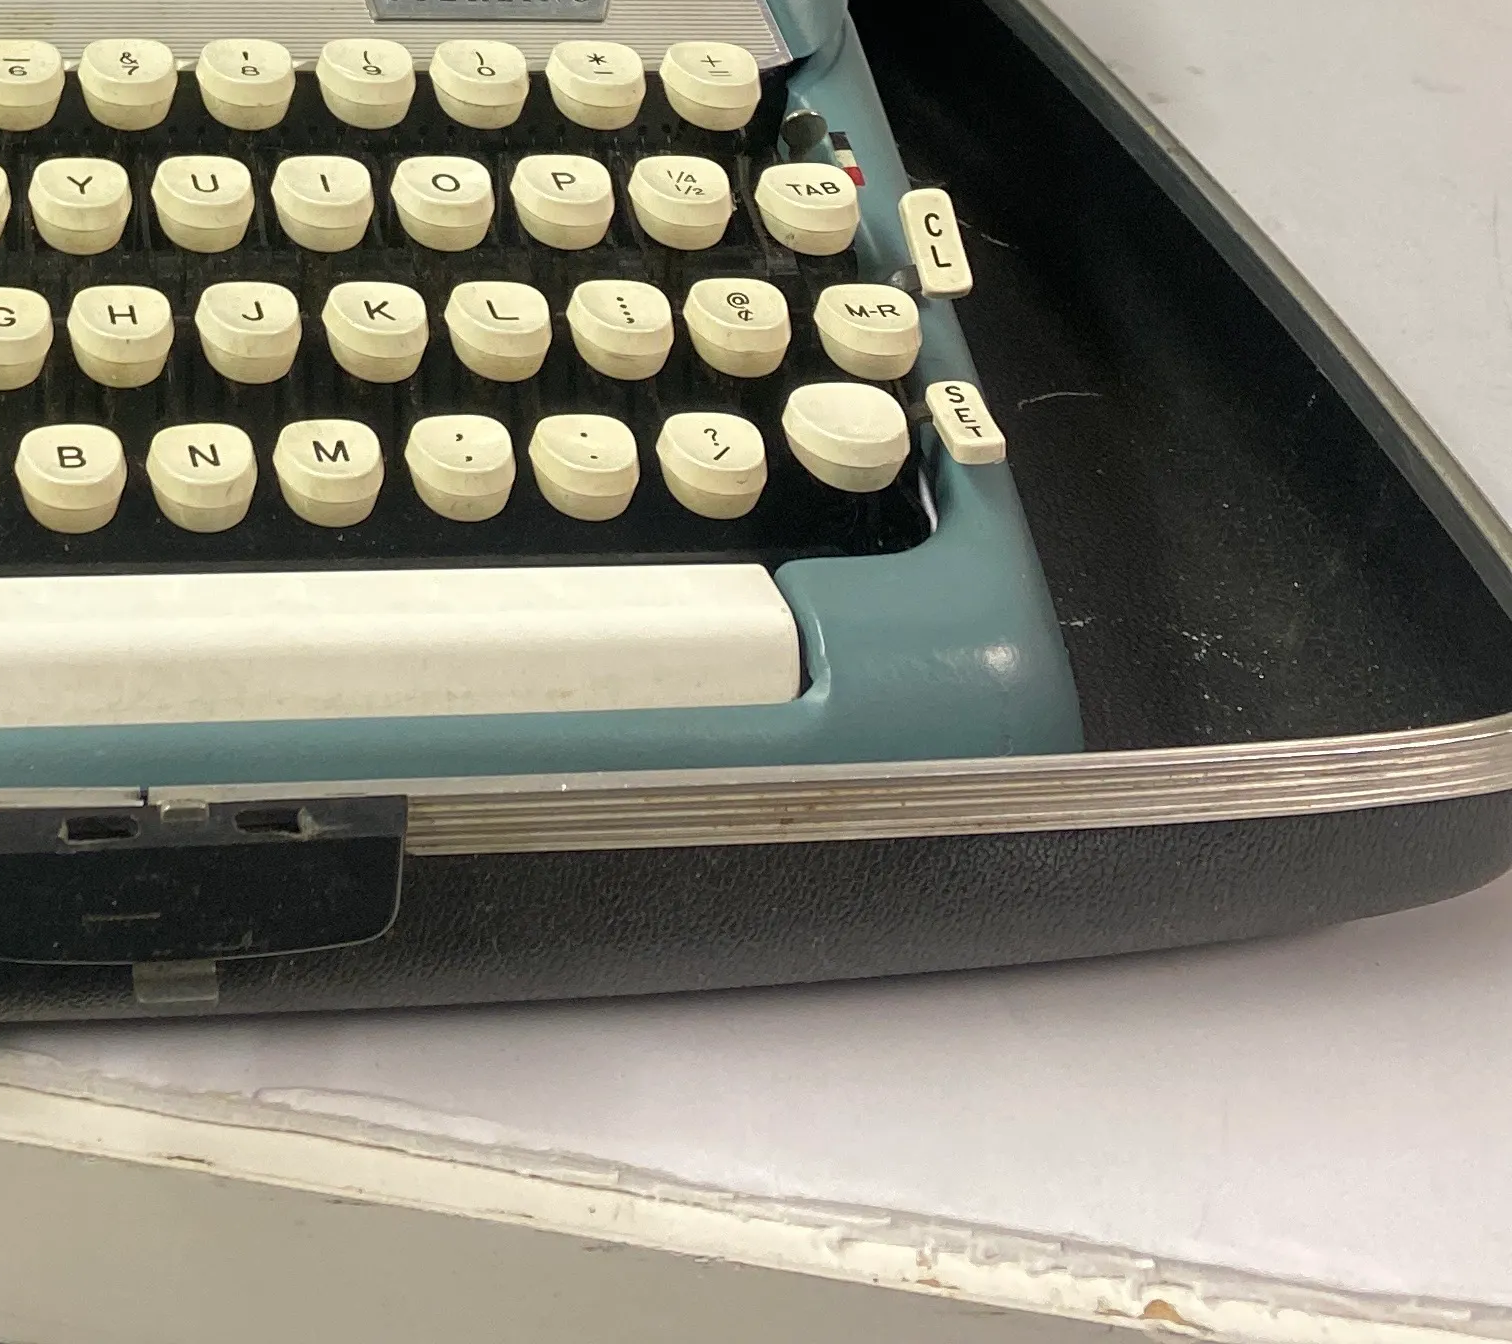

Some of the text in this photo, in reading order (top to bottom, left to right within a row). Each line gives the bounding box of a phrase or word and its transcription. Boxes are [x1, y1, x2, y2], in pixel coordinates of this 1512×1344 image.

[119, 51, 143, 66] &
[8, 65, 28, 77] 6
[122, 65, 140, 76] 7
[241, 65, 260, 77] 8
[362, 65, 382, 76] 9
[66, 175, 93, 195] Y
[190, 173, 220, 193] U
[319, 174, 331, 193] I
[431, 173, 461, 193] O
[550, 171, 576, 191] P
[785, 181, 841, 196] TAB
[363, 300, 397, 321] K
[486, 299, 520, 321] L
[726, 292, 751, 309] @
[844, 303, 901, 318] M-R
[107, 304, 138, 325] H
[241, 301, 264, 322] J
[944, 385, 983, 438] SET
[703, 428, 721, 448] ?
[56, 445, 87, 469] B
[187, 443, 221, 468] N
[312, 439, 350, 463] M
